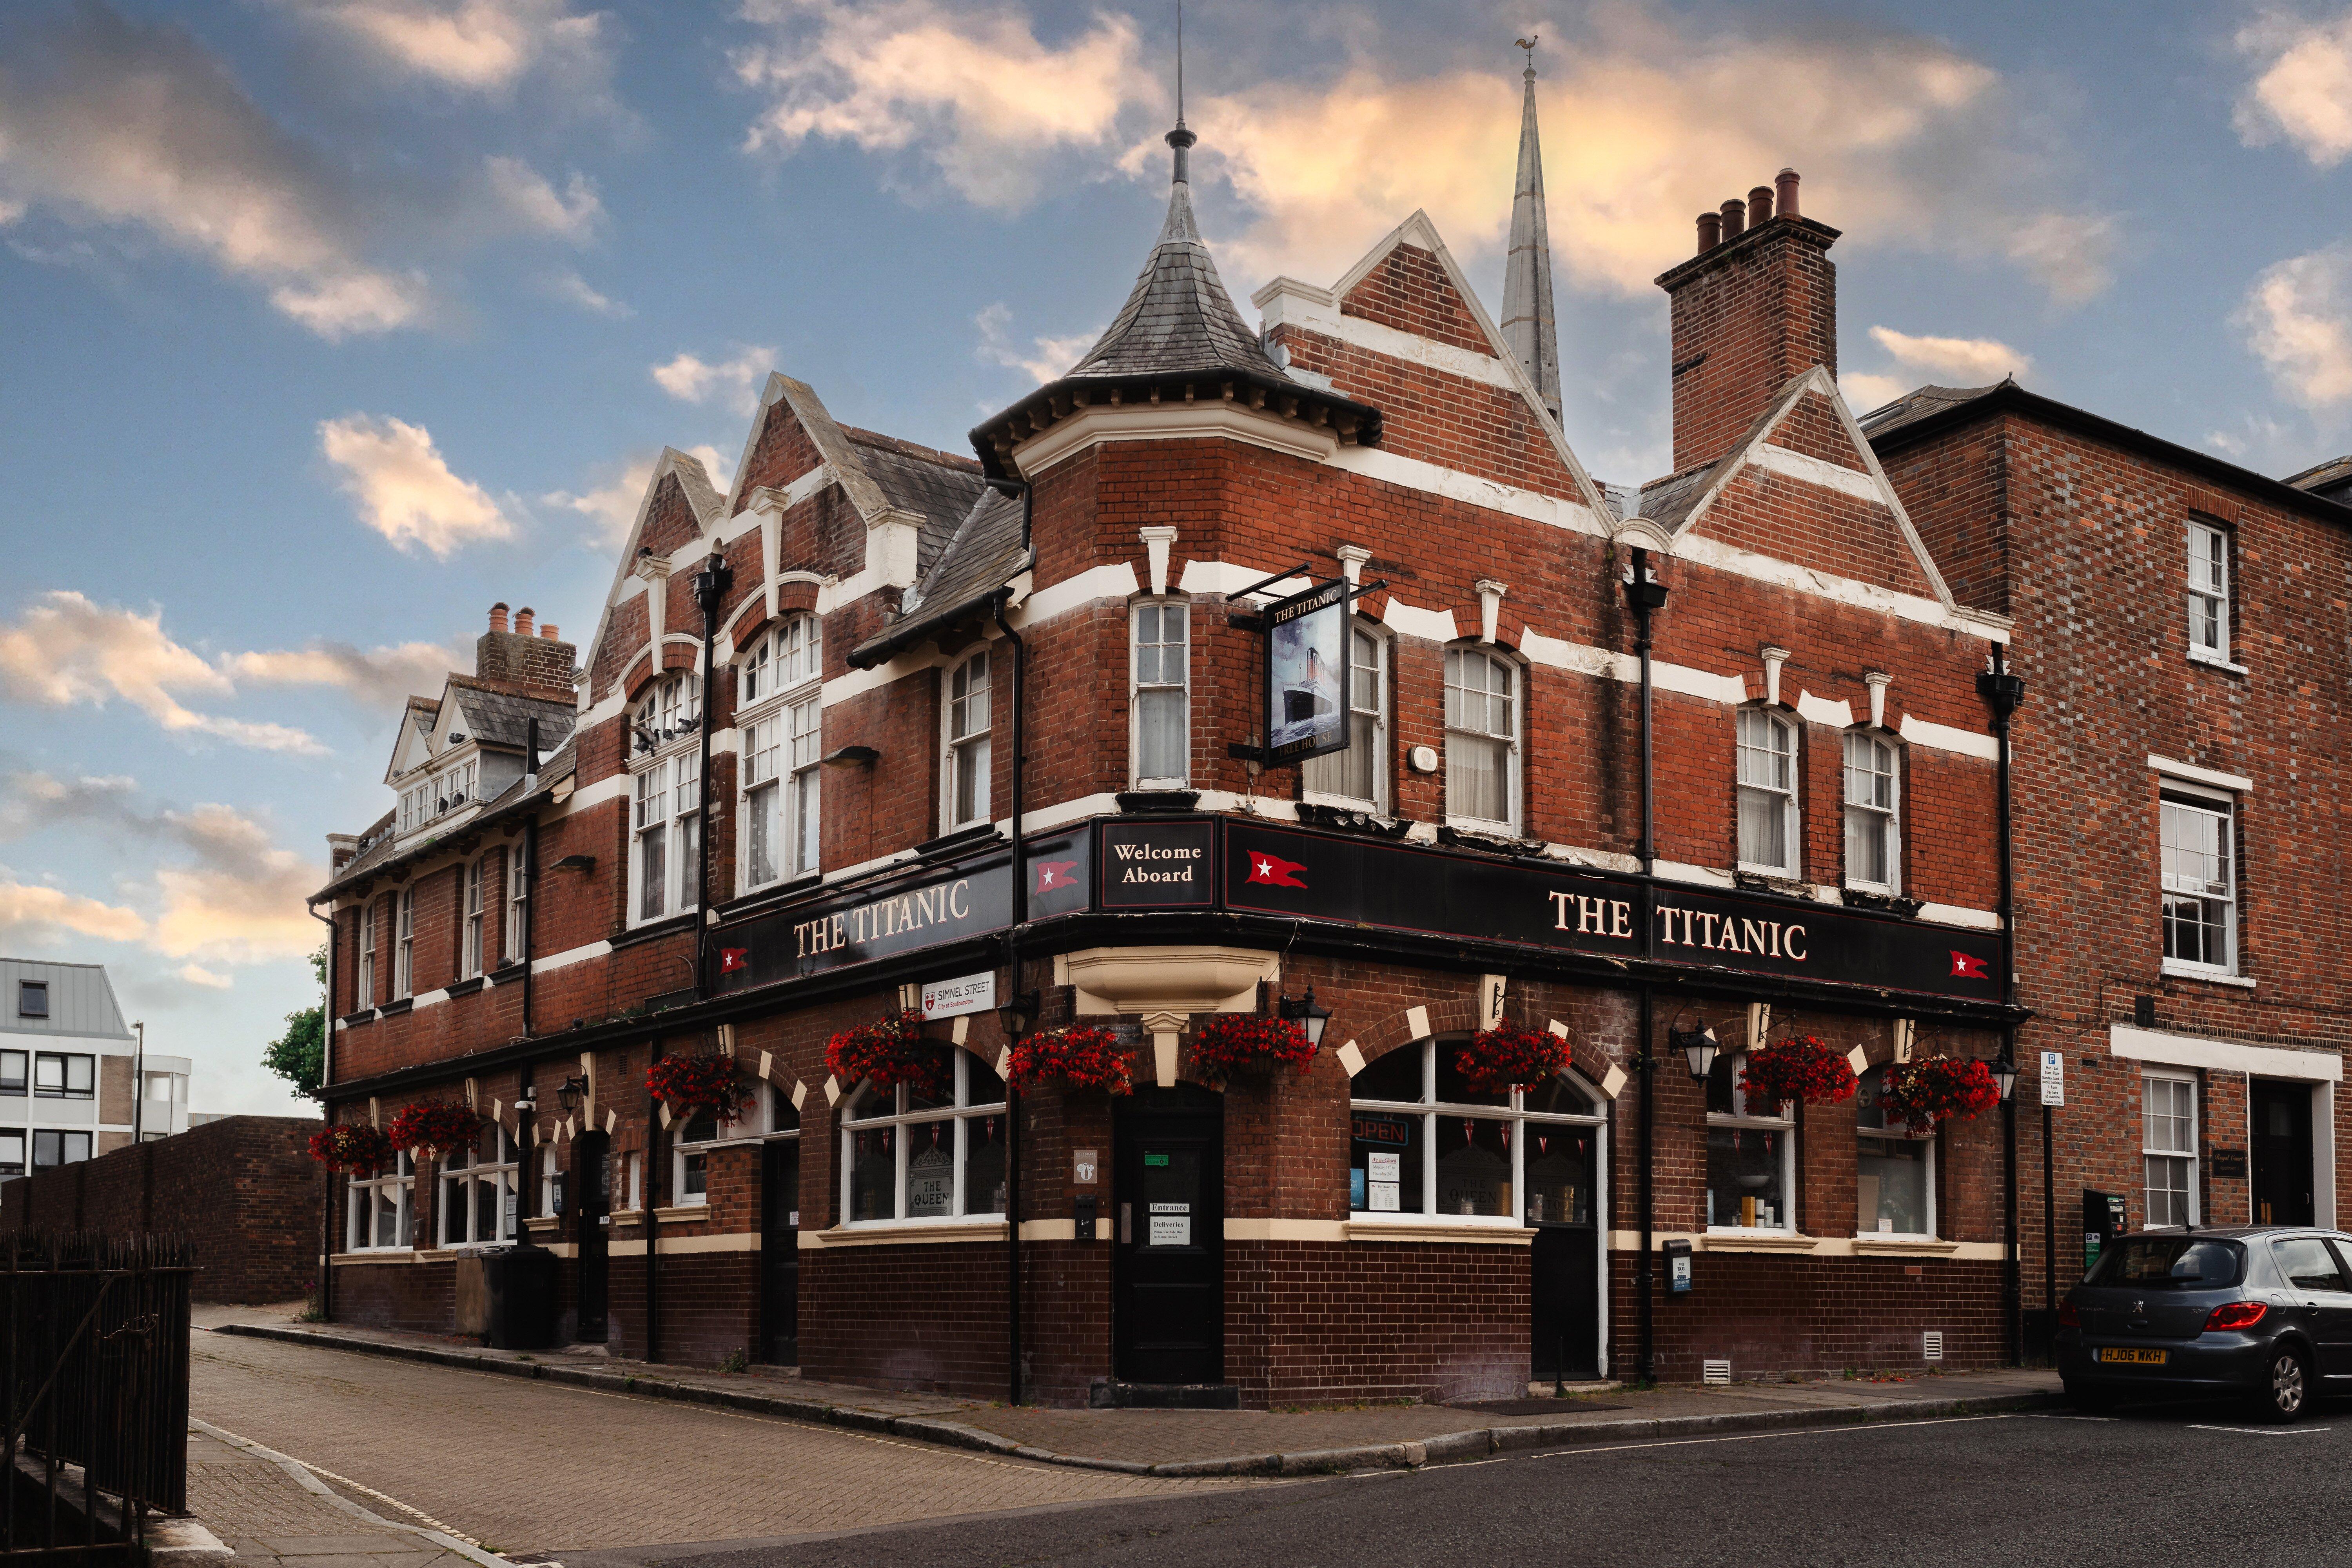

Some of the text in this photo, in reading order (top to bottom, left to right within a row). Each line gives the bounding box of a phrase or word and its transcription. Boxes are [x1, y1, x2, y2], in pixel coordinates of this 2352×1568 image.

[1275, 590, 1337, 623] THE TITANIC
[1279, 731, 1332, 757] FREE HOUSE
[1113, 843, 1201, 860] Welcome
[1122, 865, 1193, 883] Aboard
[794, 879, 969, 959] THE TITANIC
[1549, 890, 1807, 961] THE TITANIC
[938, 981, 989, 1000] SIMNEL STREET
[950, 999, 973, 1007] Southampton
[1350, 1120, 1403, 1142] OPEN
[924, 1180, 941, 1192] THE
[1462, 1179, 1486, 1189] THE
[914, 1193, 949, 1207] QUEEN
[1449, 1188, 1497, 1204] QUEEN
[2105, 1349, 2161, 1362] HJ06 WKH
